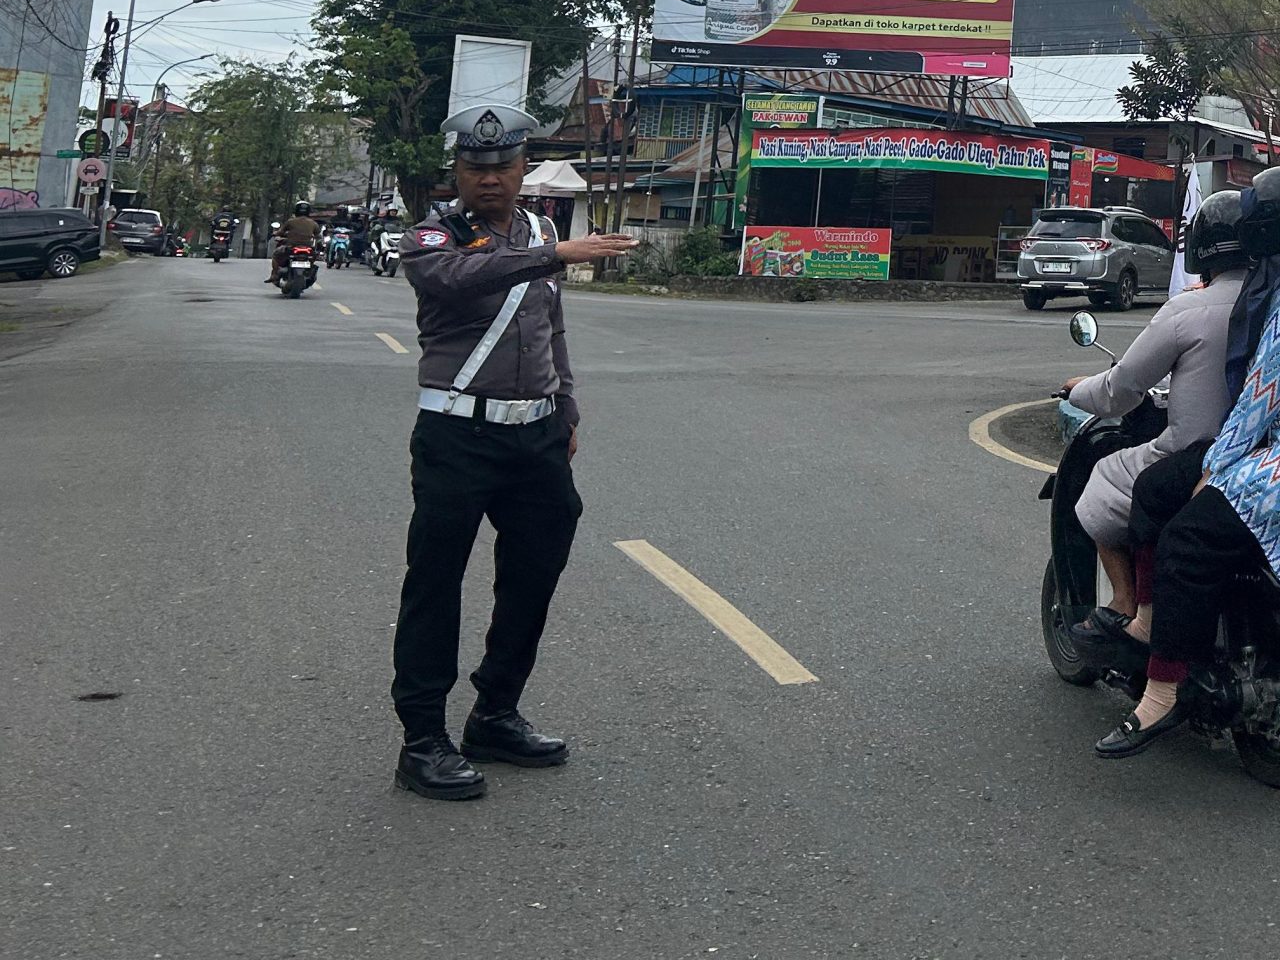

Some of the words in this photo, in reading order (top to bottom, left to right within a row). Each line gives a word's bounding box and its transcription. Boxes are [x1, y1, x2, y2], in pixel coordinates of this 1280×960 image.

[811, 16, 861, 29] Dapatkan
[863, 18, 874, 28] di
[876, 20, 899, 30] toko
[902, 21, 936, 33] karpet
[938, 23, 982, 33] terdekat
[697, 48, 711, 56] Shop
[747, 100, 772, 110] SELAMAT
[753, 111, 771, 121] PAK
[773, 113, 808, 122] DEWAN
[759, 137, 776, 157] Nasi
[777, 138, 808, 162] Kuning,
[809, 138, 828, 157] Nasi
[829, 137, 863, 162] Campur,
[863, 137, 883, 157] Nasi
[884, 137, 907, 162] Pecel,
[909, 137, 965, 161] Gado-Gado
[967, 141, 995, 170] Uleq,
[997, 145, 1025, 167] Tahu
[1026, 147, 1047, 169] Tek
[1050, 149, 1070, 159] Sudut
[1052, 160, 1069, 170] Rasa
[814, 229, 879, 243] Warmindo
[810, 248, 849, 262] Sudut
[850, 250, 880, 263] Rasa
